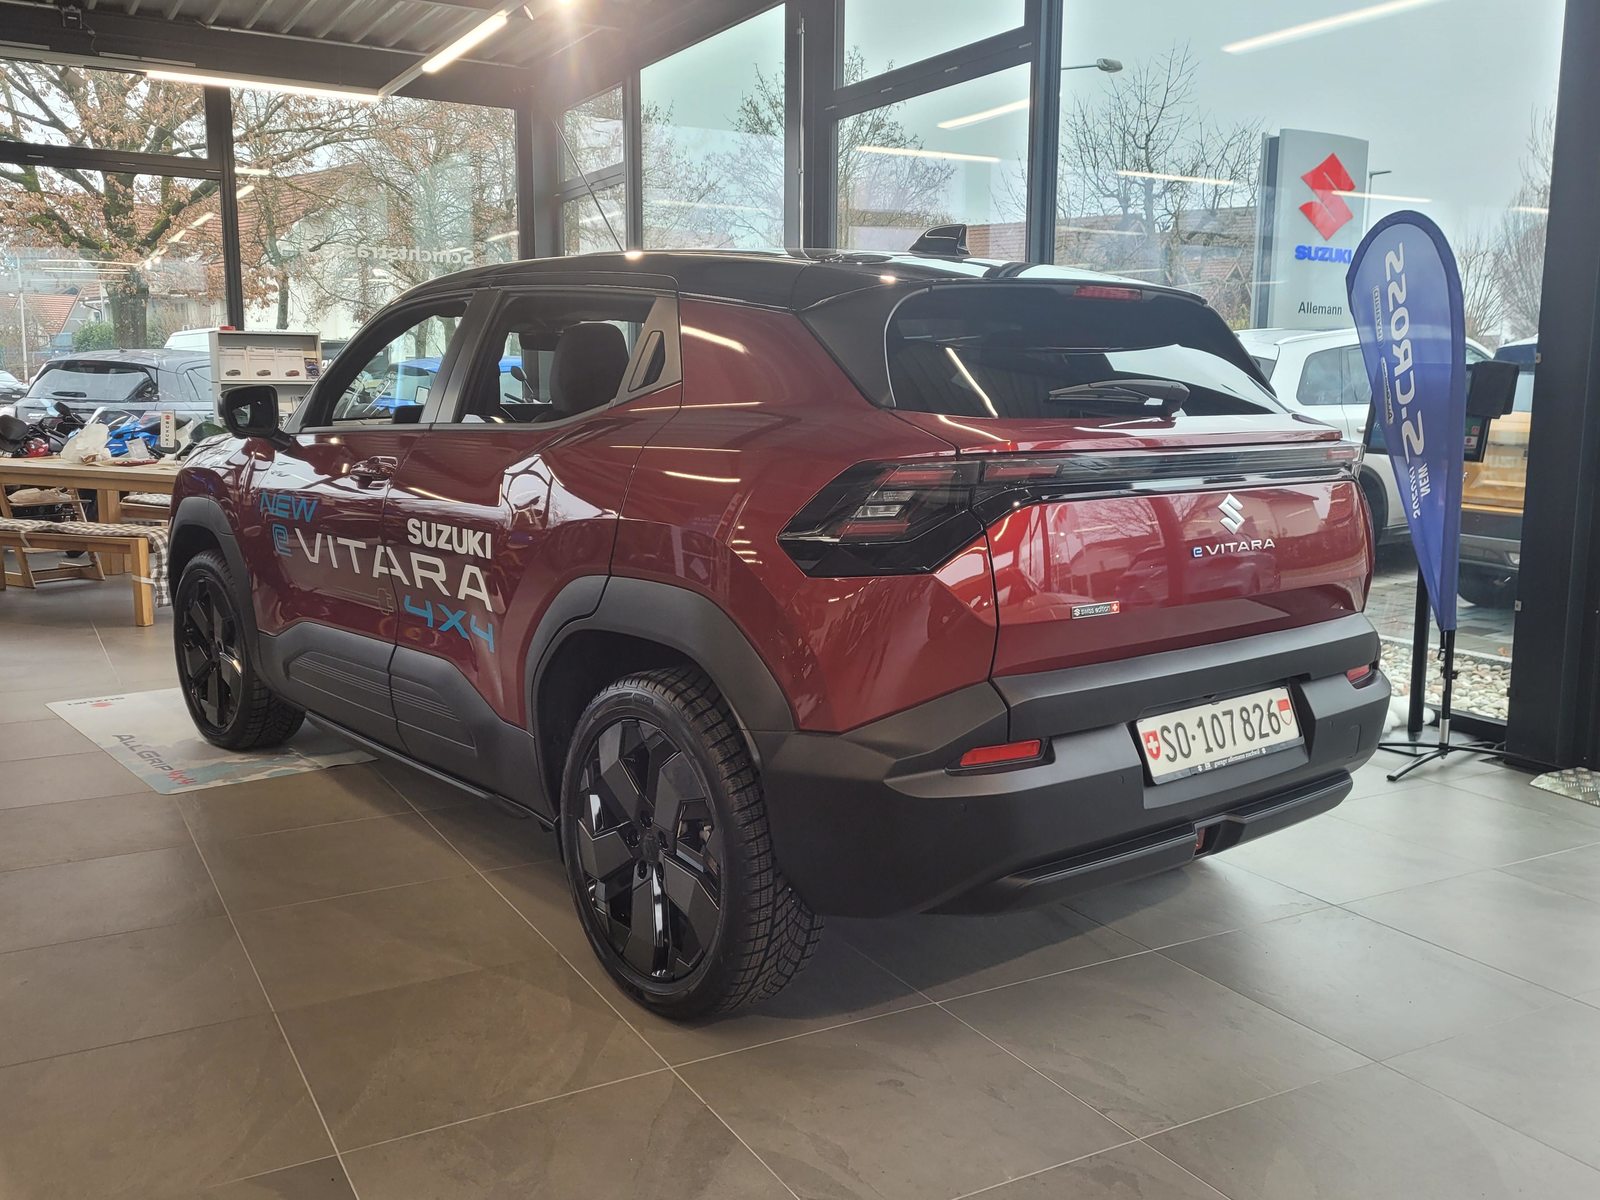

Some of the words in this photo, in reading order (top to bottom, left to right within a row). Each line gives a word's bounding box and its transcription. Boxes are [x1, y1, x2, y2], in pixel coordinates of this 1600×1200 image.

[1294, 244, 1352, 265] SUZUKI
[1298, 301, 1343, 316] Allemann
[259, 491, 318, 523] NEW
[406, 518, 492, 560] SUZUKI
